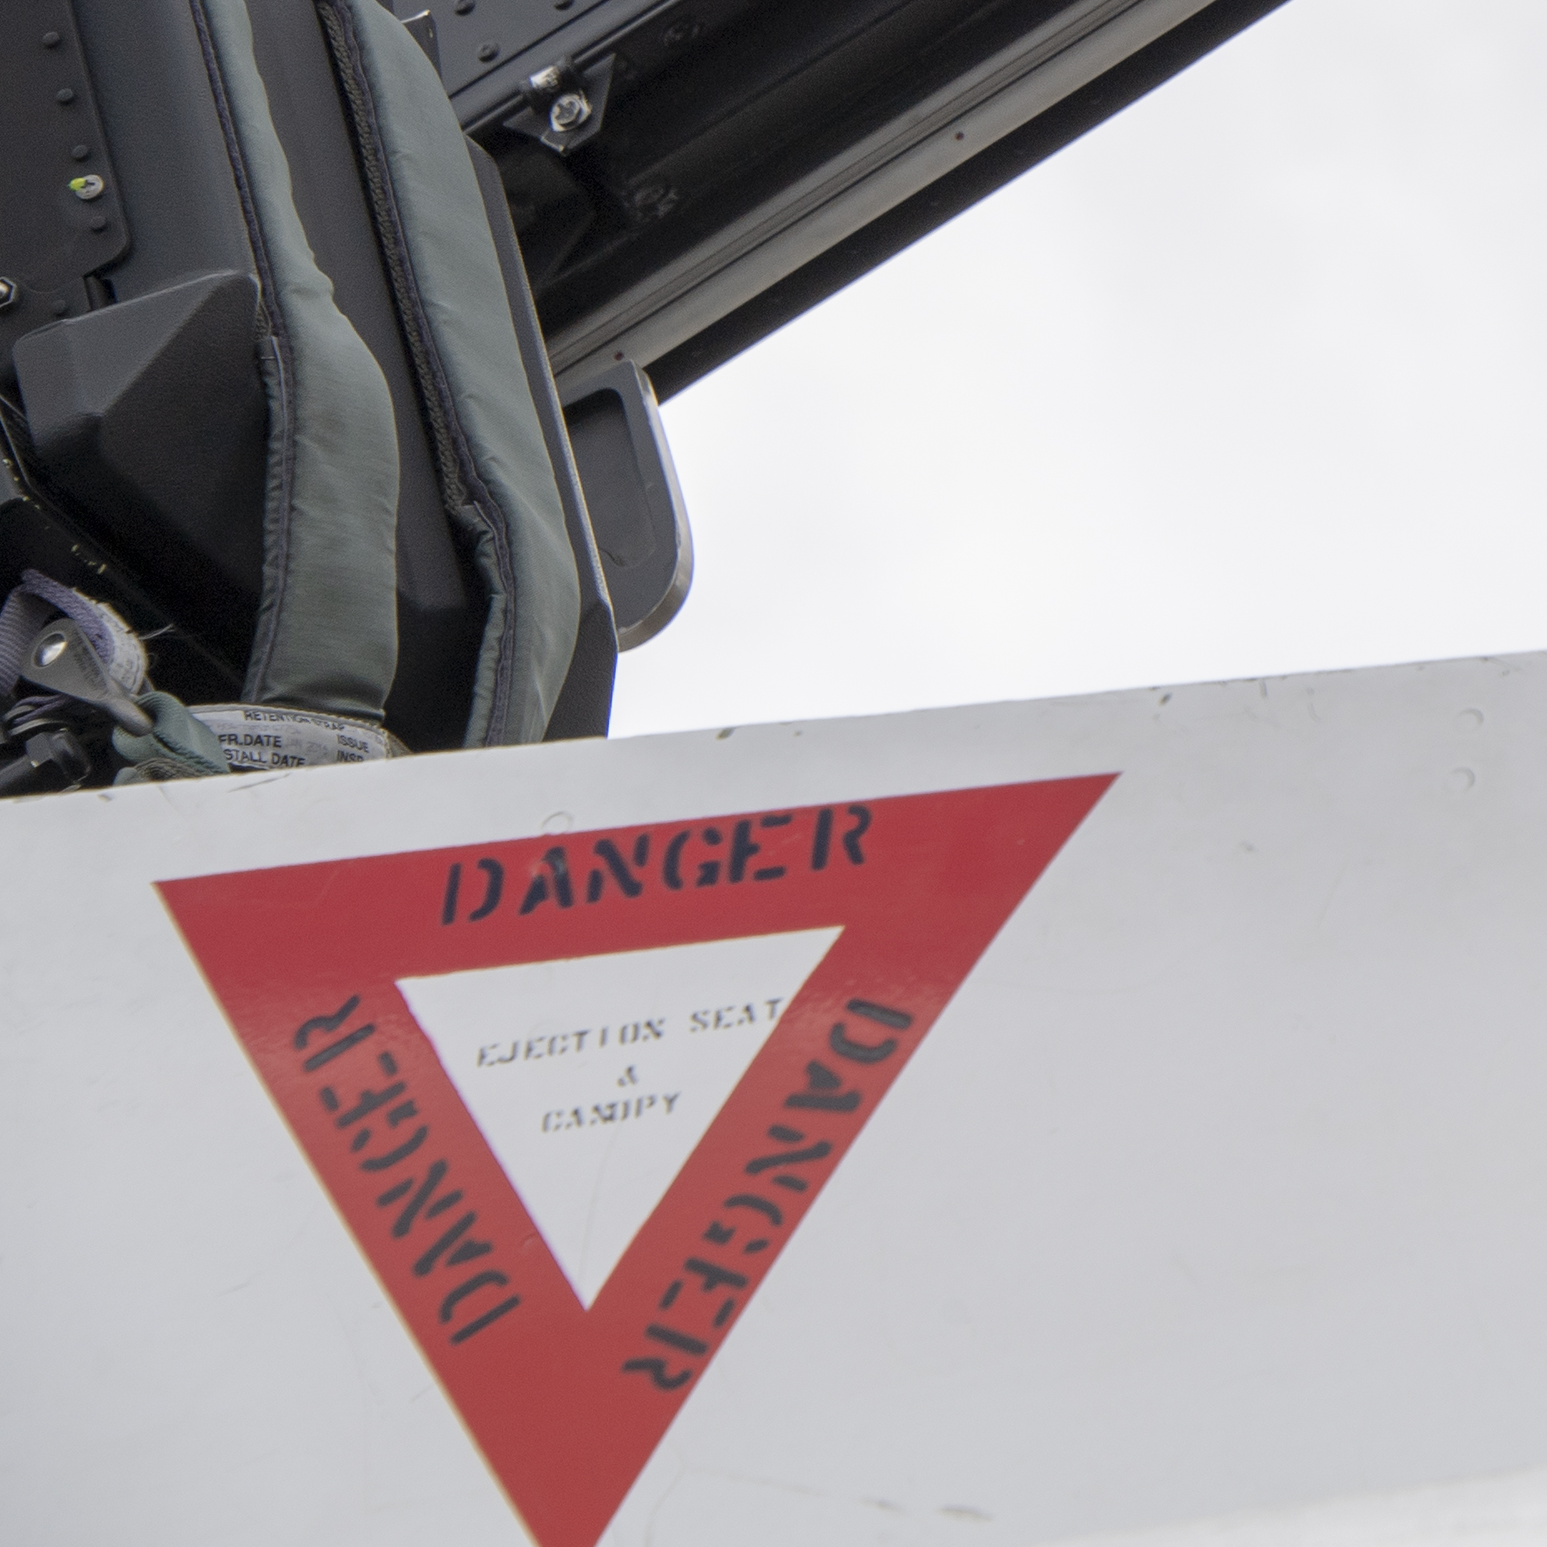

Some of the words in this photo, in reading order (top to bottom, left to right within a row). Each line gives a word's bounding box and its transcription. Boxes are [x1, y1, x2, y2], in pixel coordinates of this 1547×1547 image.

[217, 734, 283, 749] FR.DATE
[222, 748, 267, 765] STALL
[270, 753, 306, 768] DATE
[336, 734, 370, 753] ISSUE
[441, 804, 872, 925] DANGER
[476, 1017, 667, 1068] EJECTION
[689, 998, 784, 1033] SEAT
[294, 995, 521, 1345] DANGER
[622, 998, 913, 1391] DANGER
